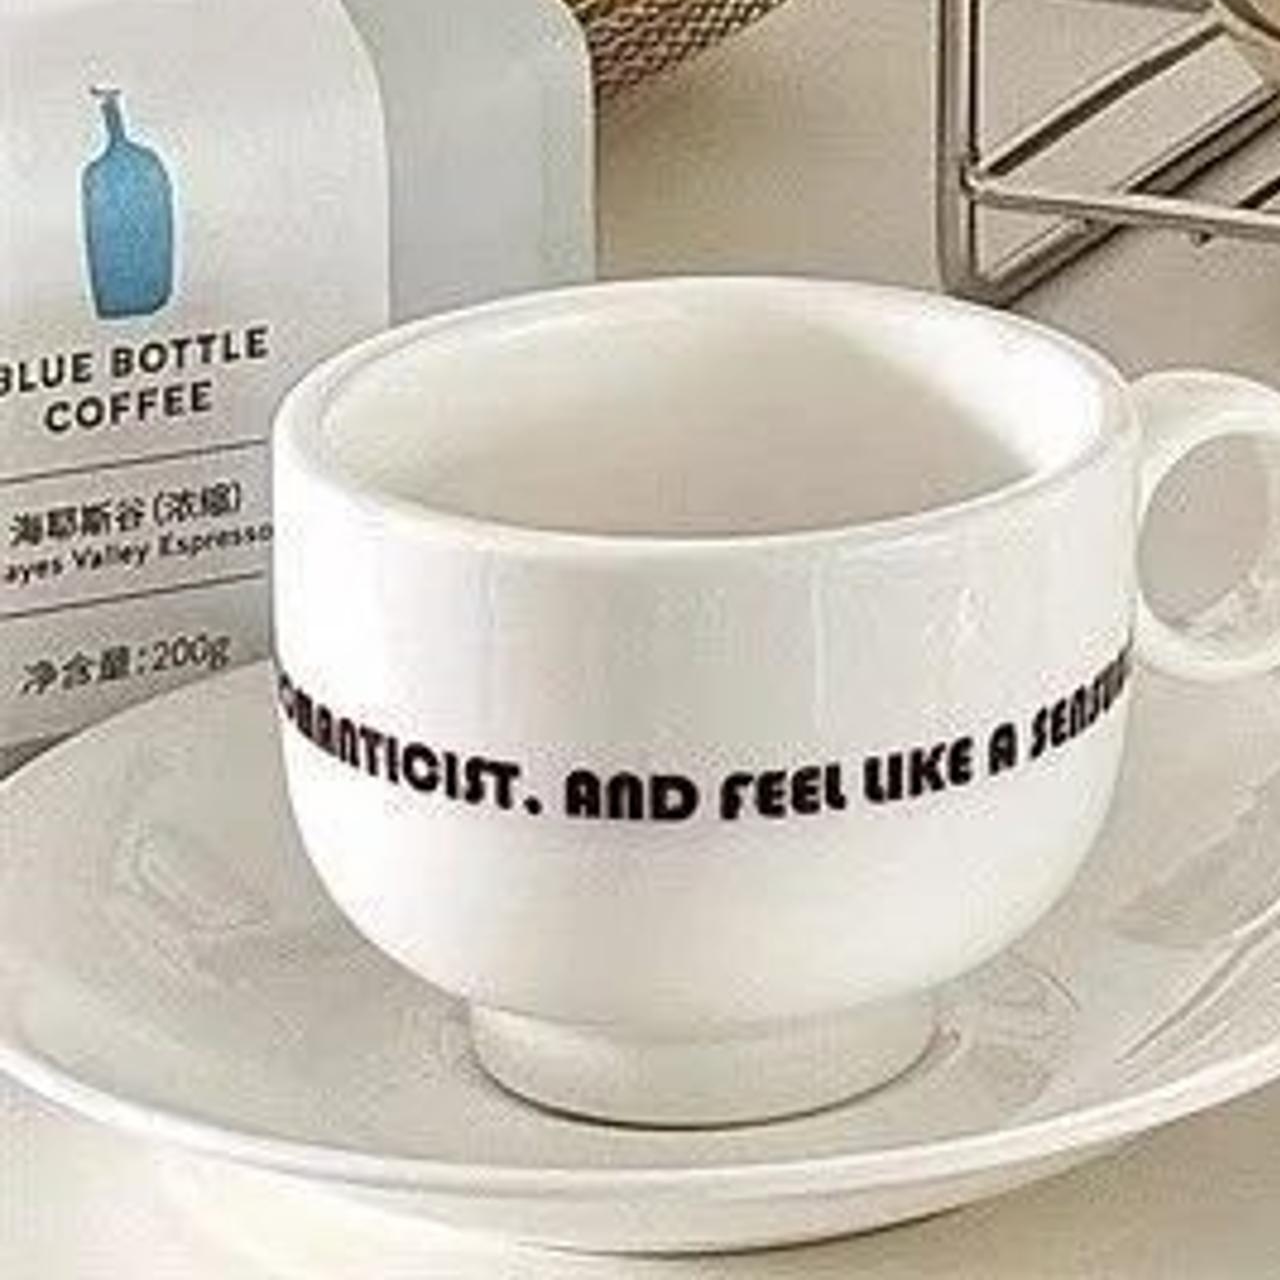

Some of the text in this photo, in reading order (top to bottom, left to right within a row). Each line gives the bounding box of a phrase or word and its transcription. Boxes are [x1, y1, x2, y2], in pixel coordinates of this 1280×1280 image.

[0, 327, 269, 396] BLUE BOTTLE
[45, 381, 213, 433] COFFEE
[72, 542, 149, 571] Valley
[158, 523, 274, 557] Espresso
[566, 770, 699, 821] AND
[720, 764, 847, 820] FEEL
[863, 735, 974, 804] LIKE
[988, 722, 1018, 776] A
